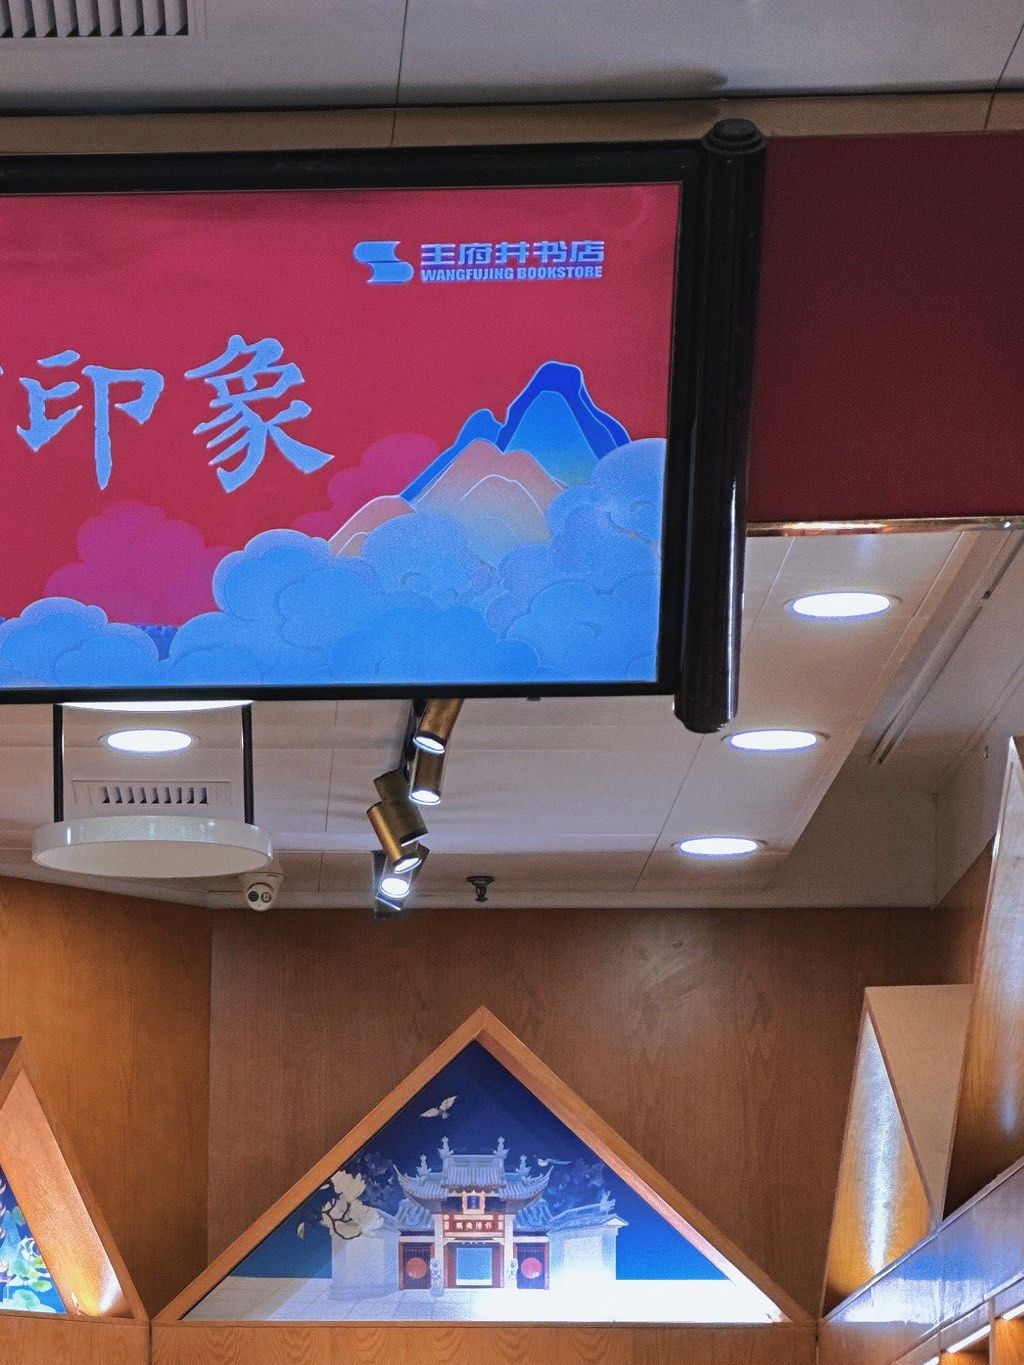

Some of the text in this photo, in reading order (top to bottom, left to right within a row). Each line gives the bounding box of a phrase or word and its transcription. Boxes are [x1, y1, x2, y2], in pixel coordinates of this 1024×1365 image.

[421, 241, 604, 265] 王府井书店
[422, 266, 602, 281] WANGFUJING BOOKSTORE
